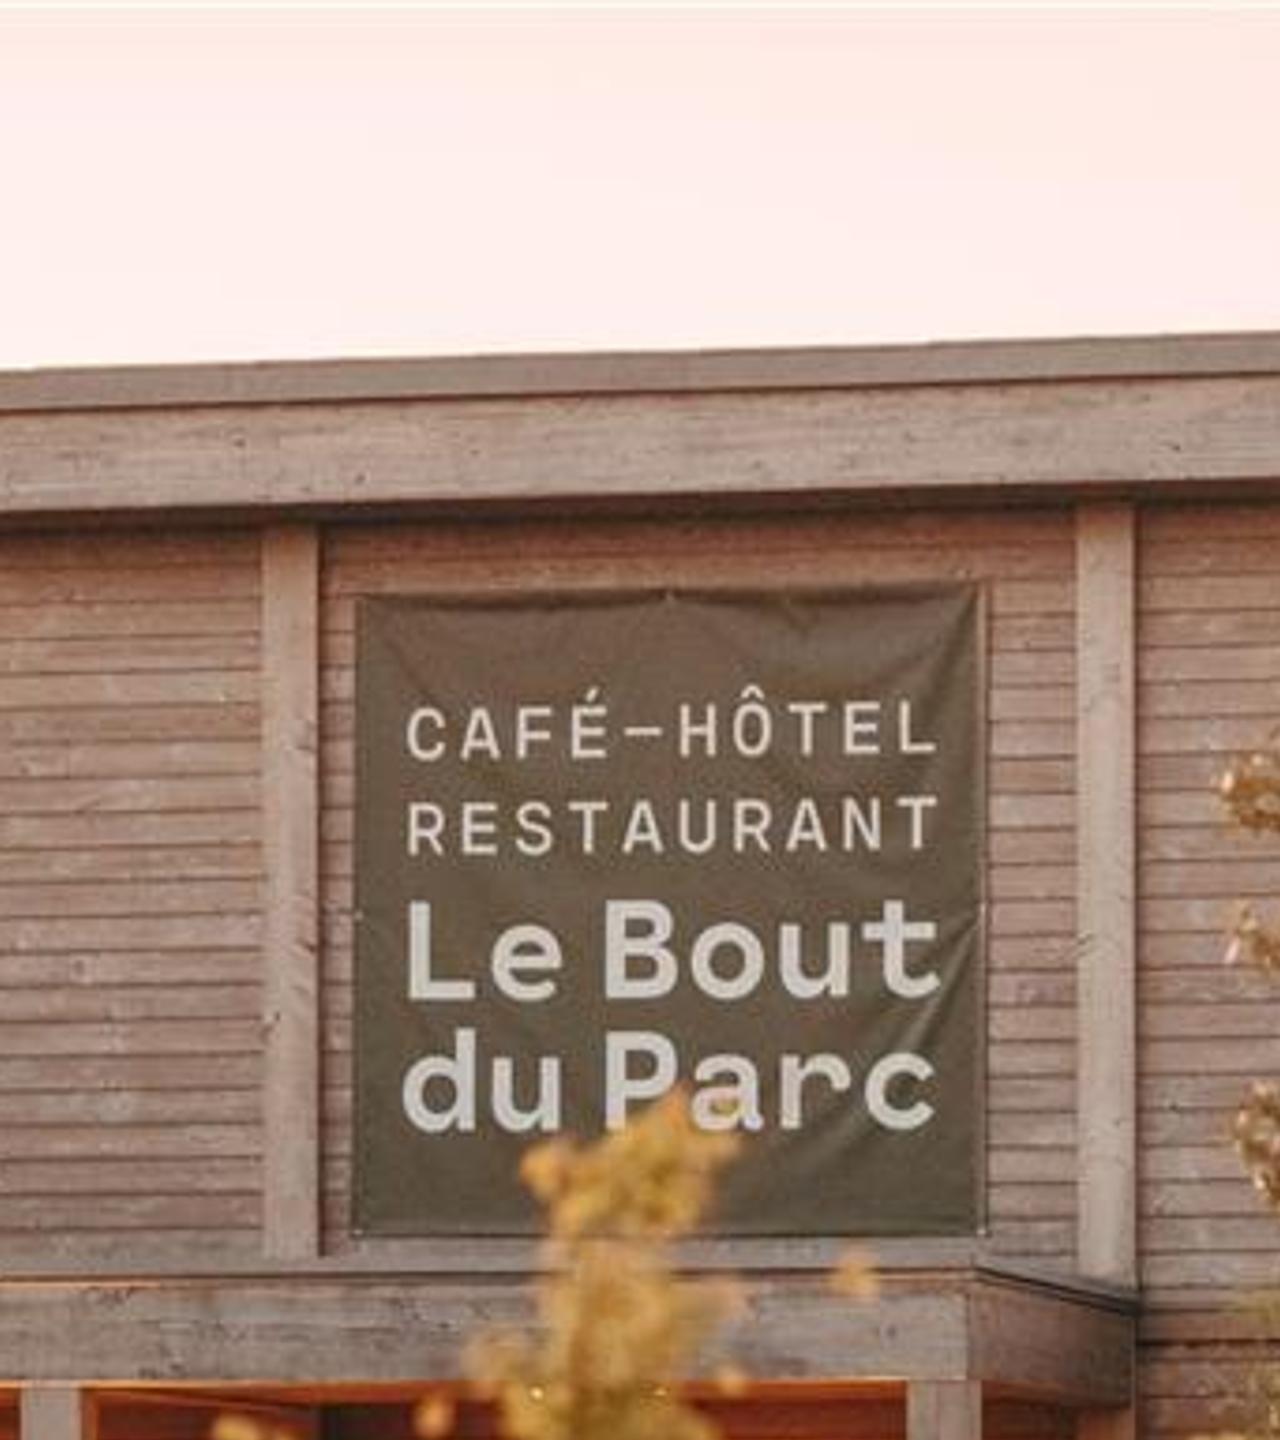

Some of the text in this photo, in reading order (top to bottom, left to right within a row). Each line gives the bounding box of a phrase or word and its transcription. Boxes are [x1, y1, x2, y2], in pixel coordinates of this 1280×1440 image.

[407, 795, 939, 856] RESTAURANT
[407, 899, 942, 1001] Le Bout
[401, 1027, 936, 1133] du Parc
